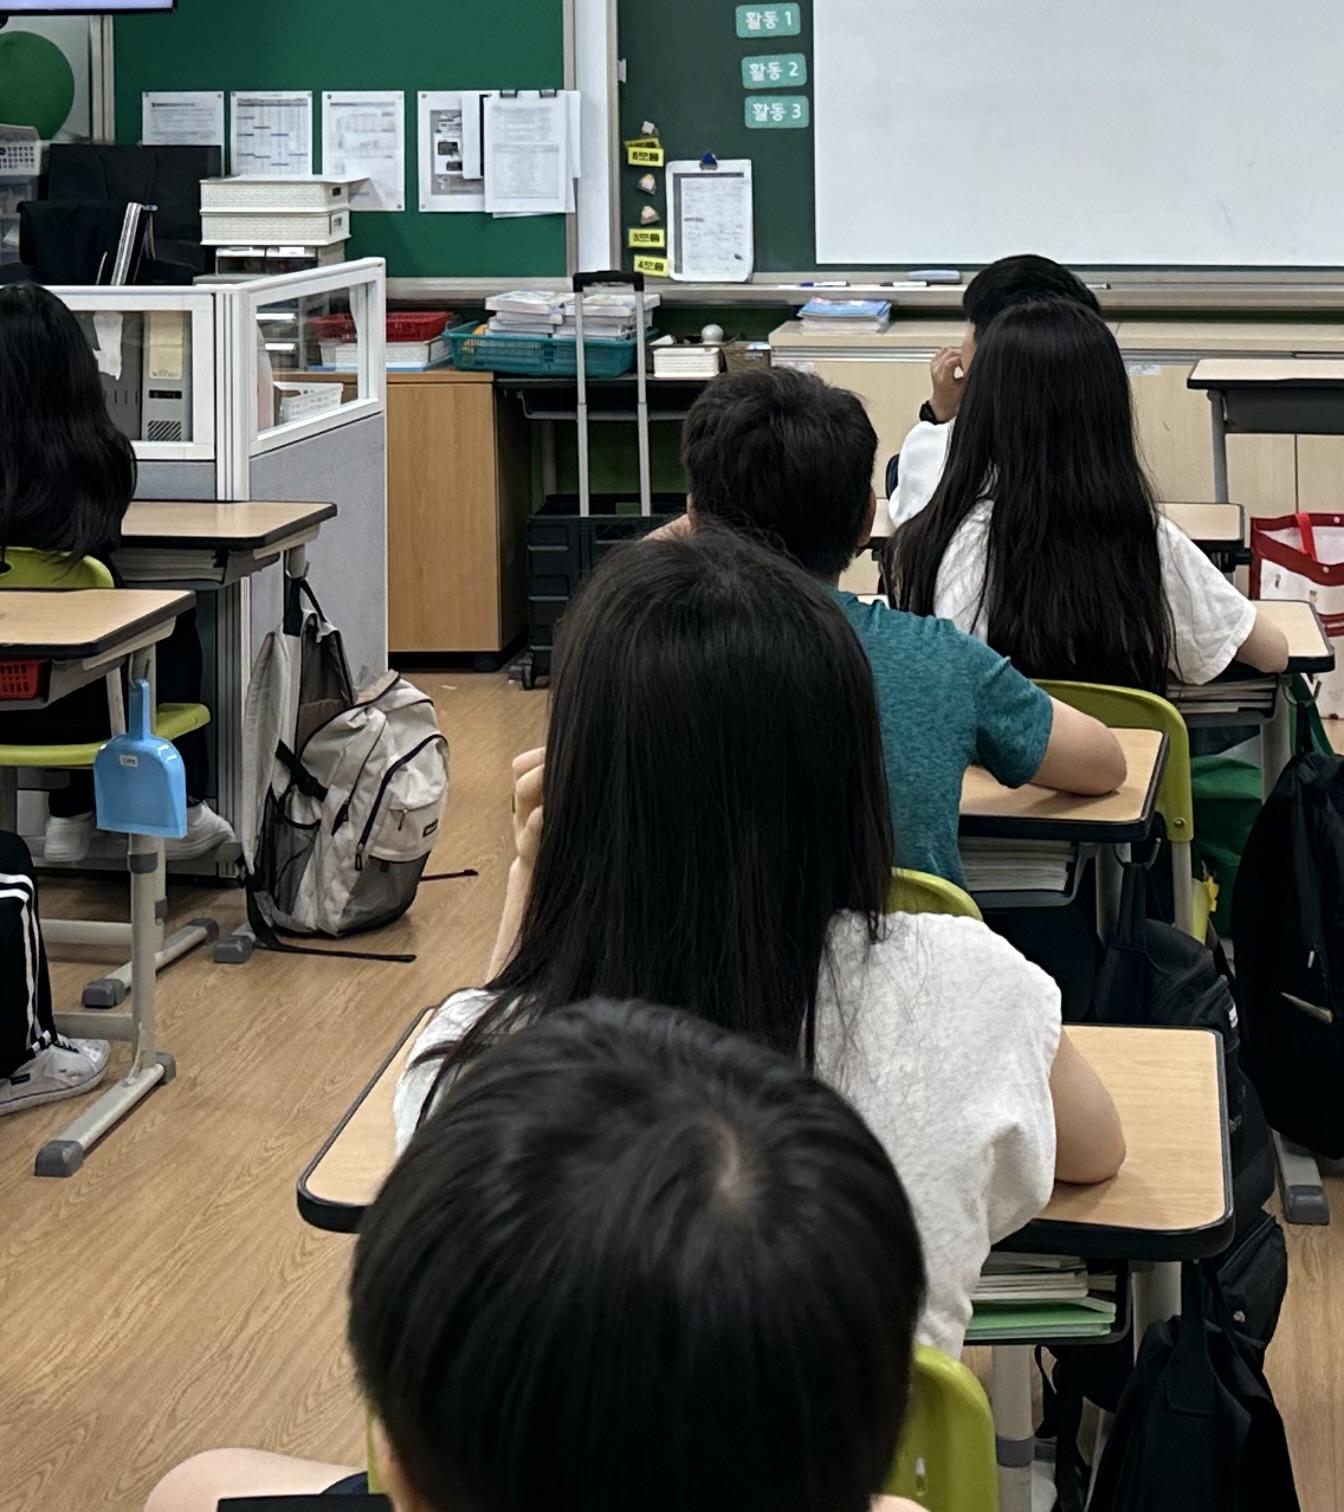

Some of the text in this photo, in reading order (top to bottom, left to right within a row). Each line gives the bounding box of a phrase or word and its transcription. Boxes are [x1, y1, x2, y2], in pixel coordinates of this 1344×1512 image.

[745, 10, 793, 31] 활동 1
[749, 61, 800, 82] 활동 2
[752, 102, 802, 122] 활동 3
